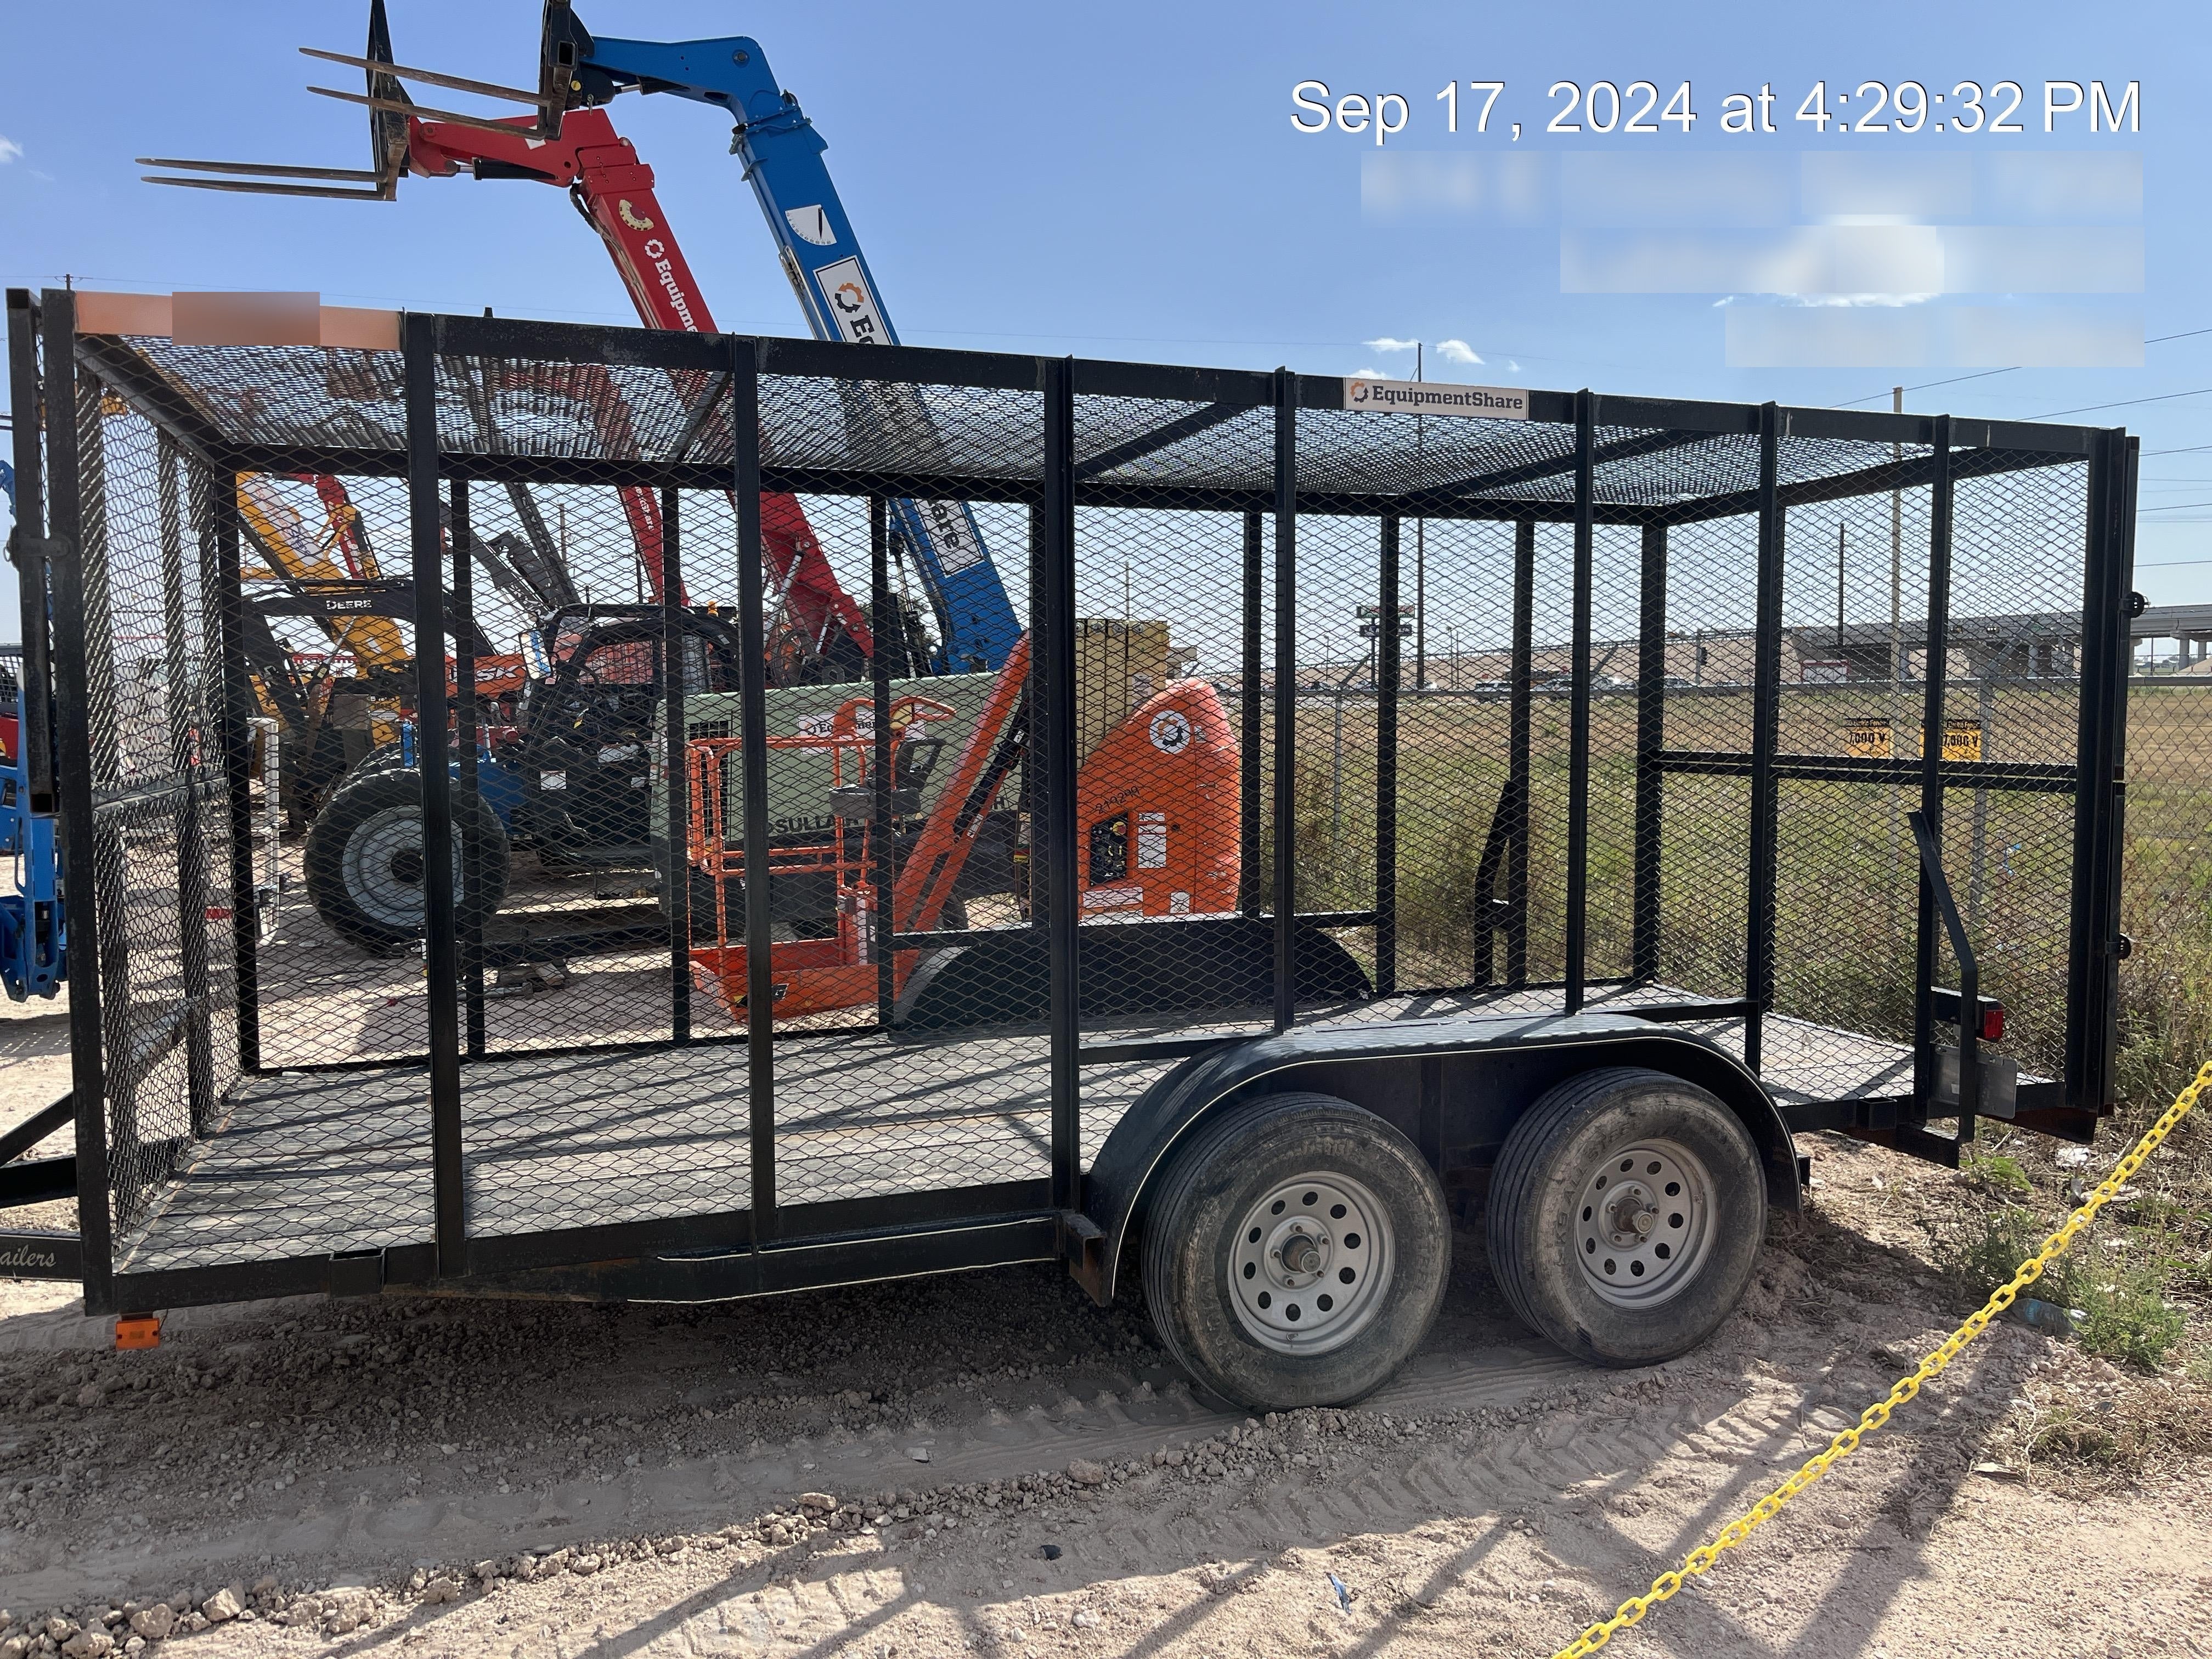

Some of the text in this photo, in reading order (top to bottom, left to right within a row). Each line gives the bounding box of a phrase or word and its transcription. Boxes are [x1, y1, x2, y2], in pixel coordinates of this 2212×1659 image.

[1372, 386, 1523, 409] EquipmentShare
[325, 600, 372, 610] DEERE
[0, 1244, 57, 1267] ailers
